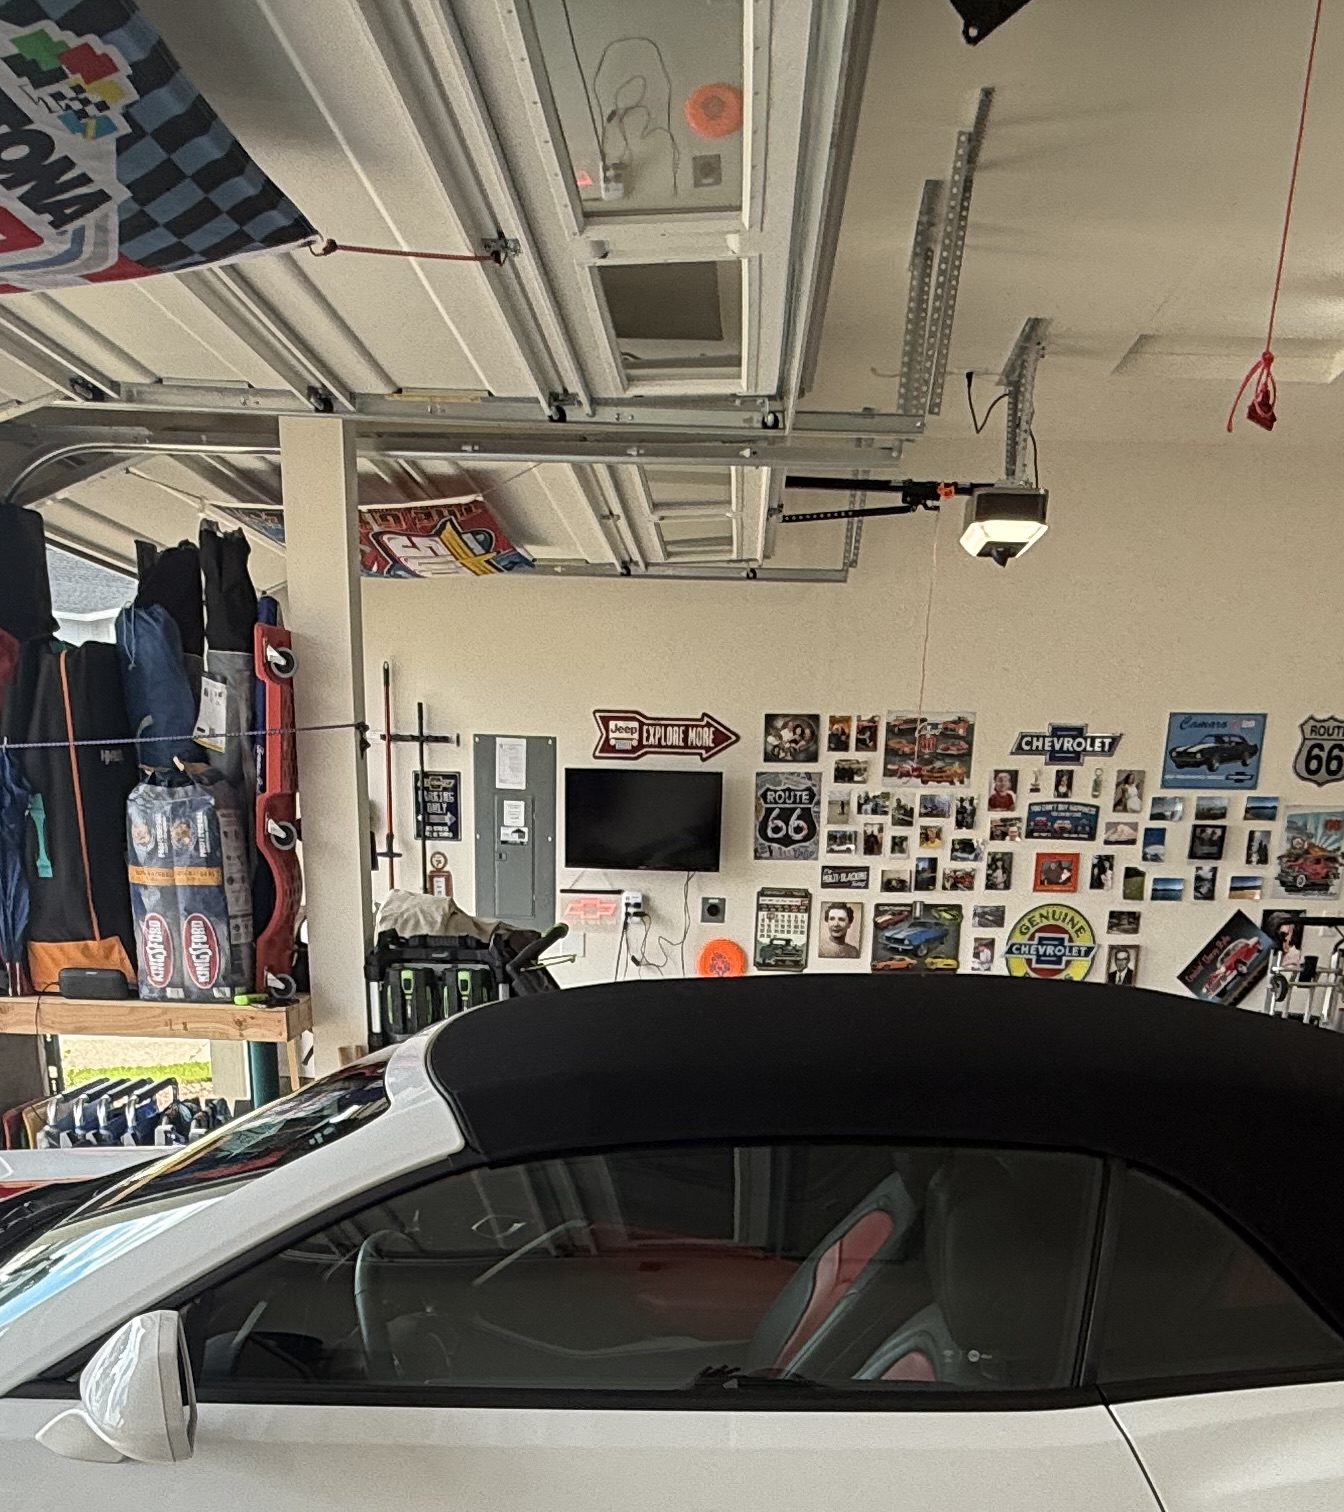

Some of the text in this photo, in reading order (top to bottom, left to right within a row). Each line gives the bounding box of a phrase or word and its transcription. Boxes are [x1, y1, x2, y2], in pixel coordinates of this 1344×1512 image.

[610, 722, 638, 735] Jeep
[1179, 715, 1228, 730] Camaro
[642, 724, 716, 748] EXPLORE MORE
[1021, 736, 1113, 752] CHEVROLET
[766, 791, 811, 804] ROUTE
[766, 807, 809, 840] 66
[1019, 909, 1087, 938] GENUINE
[145, 919, 168, 982] KINGSFORD
[188, 919, 213, 983] KINGSFORD
[1011, 944, 1088, 957] CHEVROLET
